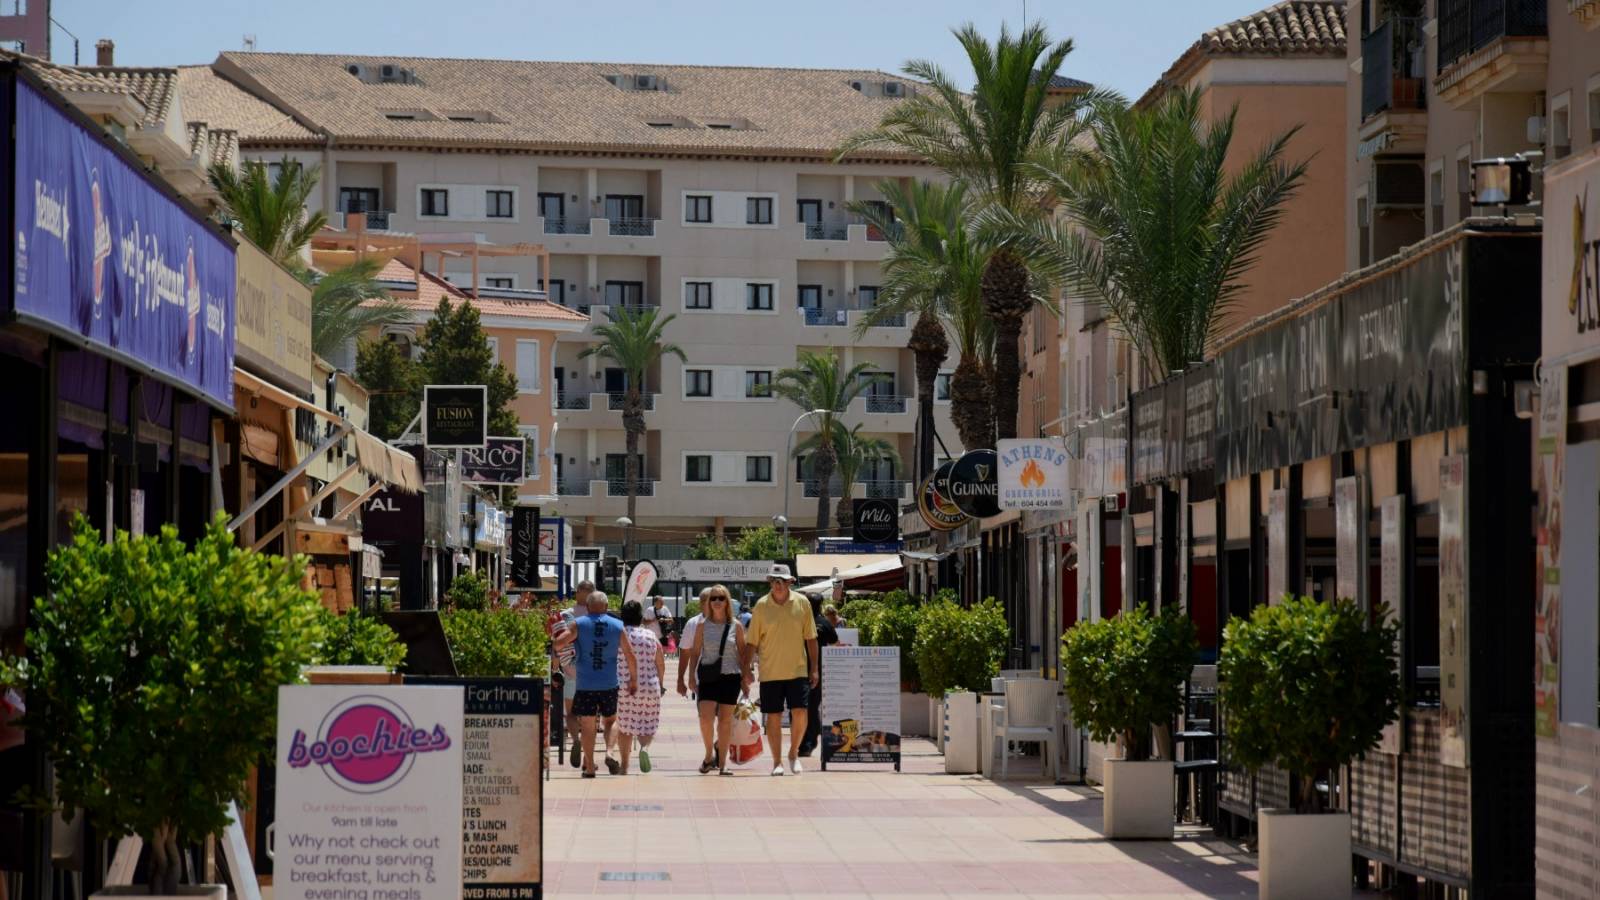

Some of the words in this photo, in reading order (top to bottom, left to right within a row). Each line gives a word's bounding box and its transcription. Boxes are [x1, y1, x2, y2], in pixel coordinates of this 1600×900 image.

[437, 407, 474, 420] FUSION
[468, 447, 517, 467] RICO
[1002, 445, 1066, 468] ATHENS
[952, 482, 999, 496] GUINNE
[860, 508, 891, 523] Milo
[467, 685, 529, 705] Farthing
[464, 718, 515, 728] BREAKFAST
[466, 731, 490, 740] LARGE
[288, 719, 452, 768] boochies
[464, 741, 490, 750] EDIUM
[466, 751, 491, 760] SMALL
[473, 775, 512, 784] POTATOES
[464, 786, 520, 796] ES/BAGUETTES
[478, 796, 501, 805] ROLLS
[323, 803, 361, 813] kitchen
[364, 803, 372, 813] is
[374, 805, 401, 816] open
[404, 803, 427, 813] from
[331, 816, 357, 828] 9am
[360, 816, 373, 827] till
[376, 816, 398, 827] late
[478, 820, 507, 830] LUNCH
[288, 833, 324, 850] Why
[328, 835, 355, 849] not
[360, 834, 408, 849] check
[413, 836, 440, 849] out
[473, 833, 498, 842] MASH
[468, 845, 488, 854] CON
[490, 845, 519, 854] CARNE
[294, 854, 319, 865] our
[325, 854, 371, 865] menu
[375, 853, 433, 868] serving
[464, 857, 512, 867] IES/QUICHE
[290, 869, 372, 885] breakfast,
[377, 869, 420, 884] lunch
[425, 870, 436, 884] &
[305, 887, 368, 900] evening
[373, 887, 421, 900] meals
[486, 888, 510, 899] FROM
[512, 889, 517, 898] 5
[519, 888, 533, 898] PM
